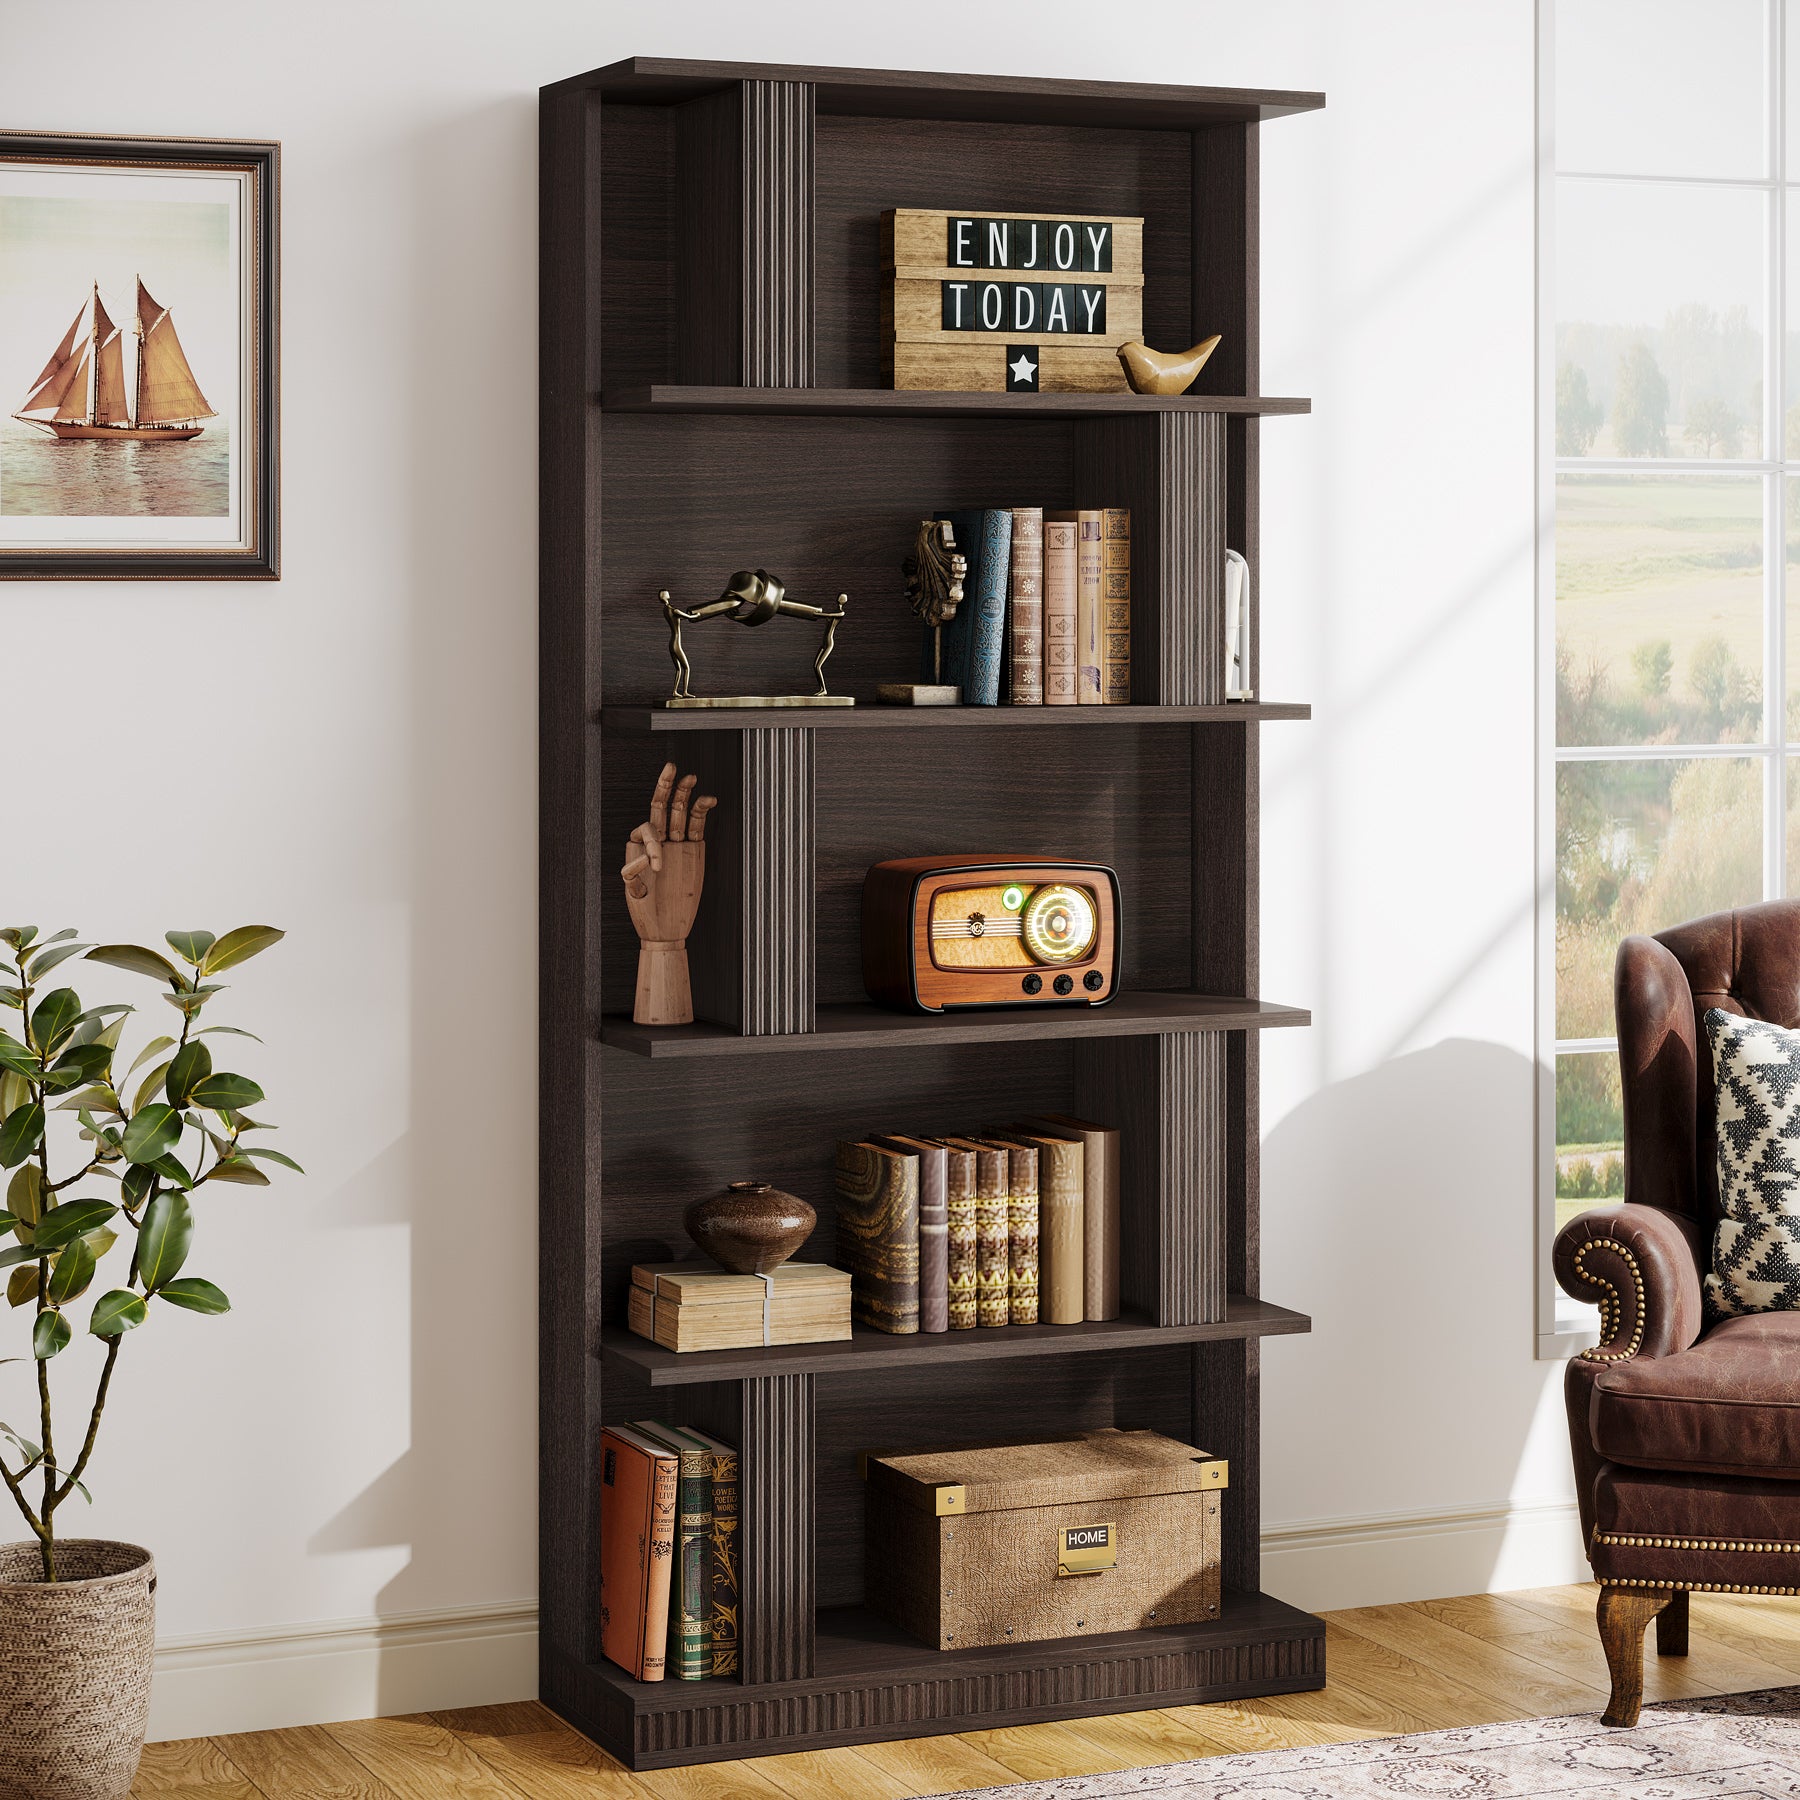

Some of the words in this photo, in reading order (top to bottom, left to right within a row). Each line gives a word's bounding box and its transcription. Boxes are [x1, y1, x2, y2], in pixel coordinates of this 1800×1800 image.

[956, 220, 1108, 272] ENJOY
[949, 284, 1102, 333] TODAY
[1068, 1530, 1107, 1545] HOME
